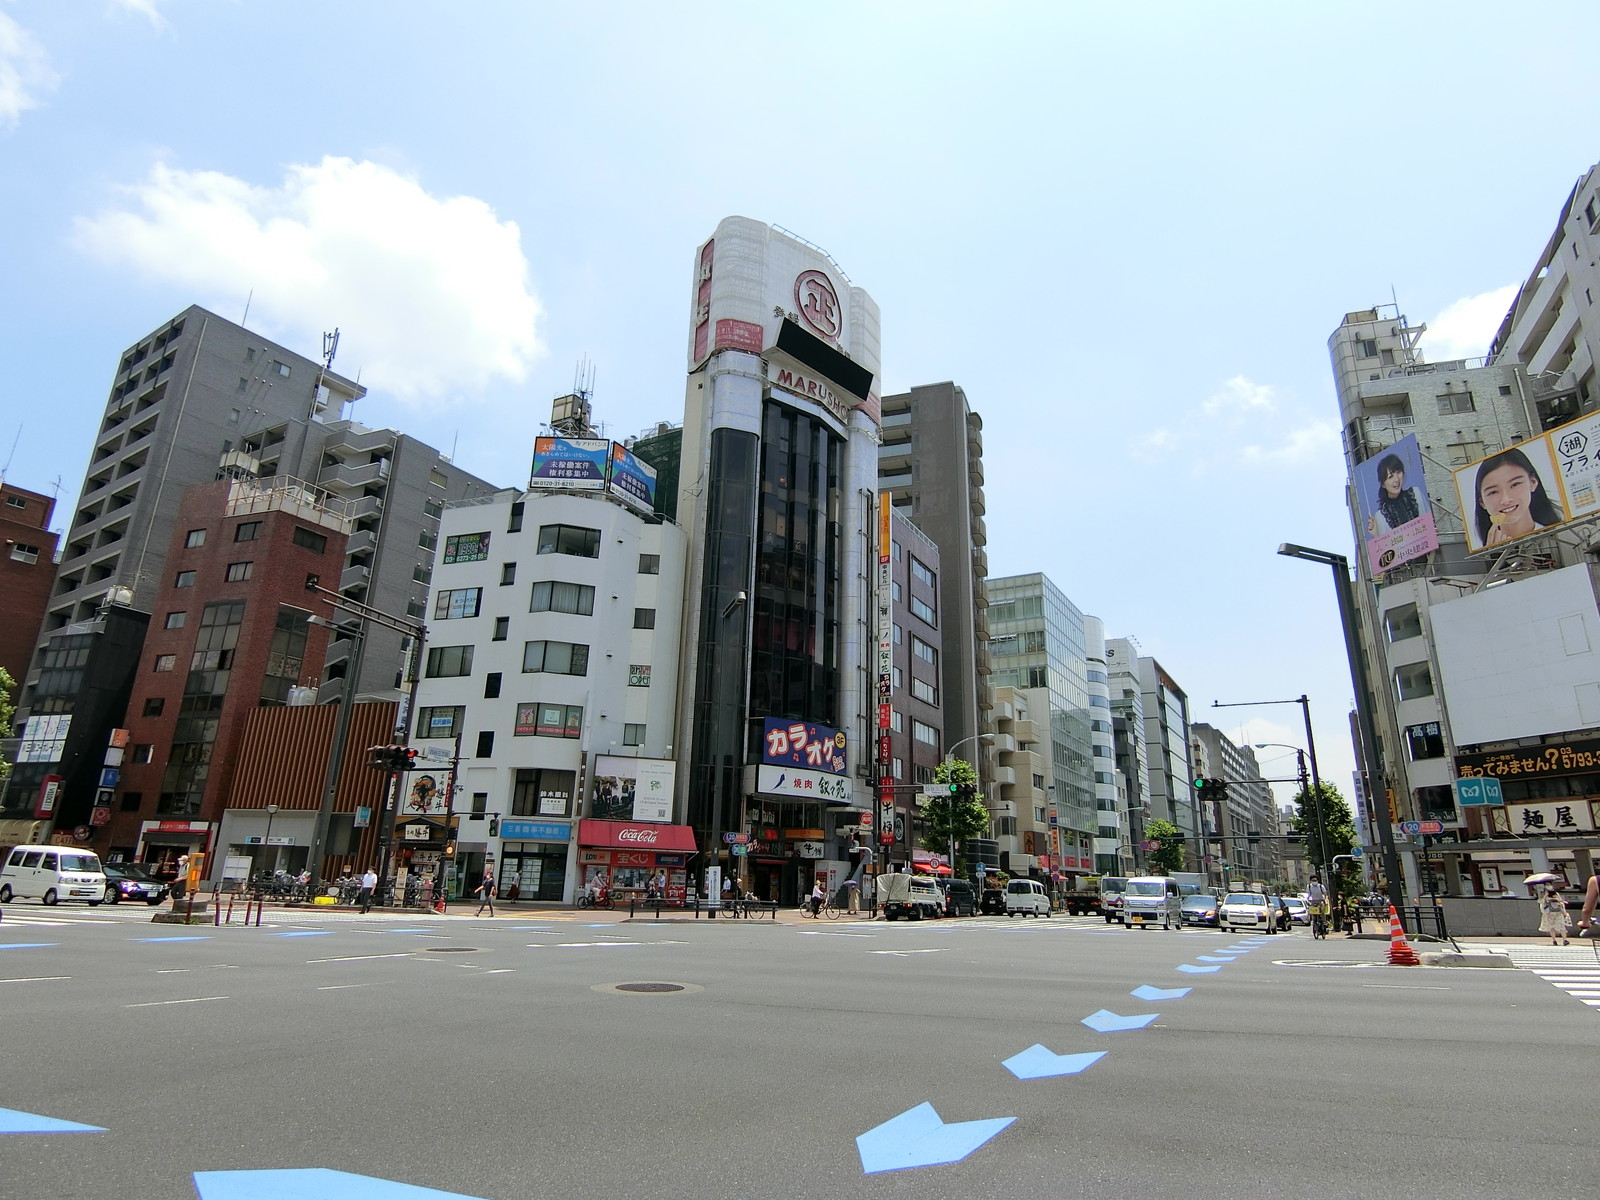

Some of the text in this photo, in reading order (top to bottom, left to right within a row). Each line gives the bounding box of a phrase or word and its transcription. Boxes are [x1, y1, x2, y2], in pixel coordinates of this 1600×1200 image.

[1564, 437, 1582, 453] 湖
[548, 469, 589, 477] 権利募集中
[767, 724, 835, 765] カラオケ
[1560, 747, 1572, 755] 03
[793, 778, 813, 789] 焼肉
[818, 776, 846, 799] 叙々苑
[619, 829, 659, 843] Coca-Cola
[617, 853, 649, 864] 宝くじ
